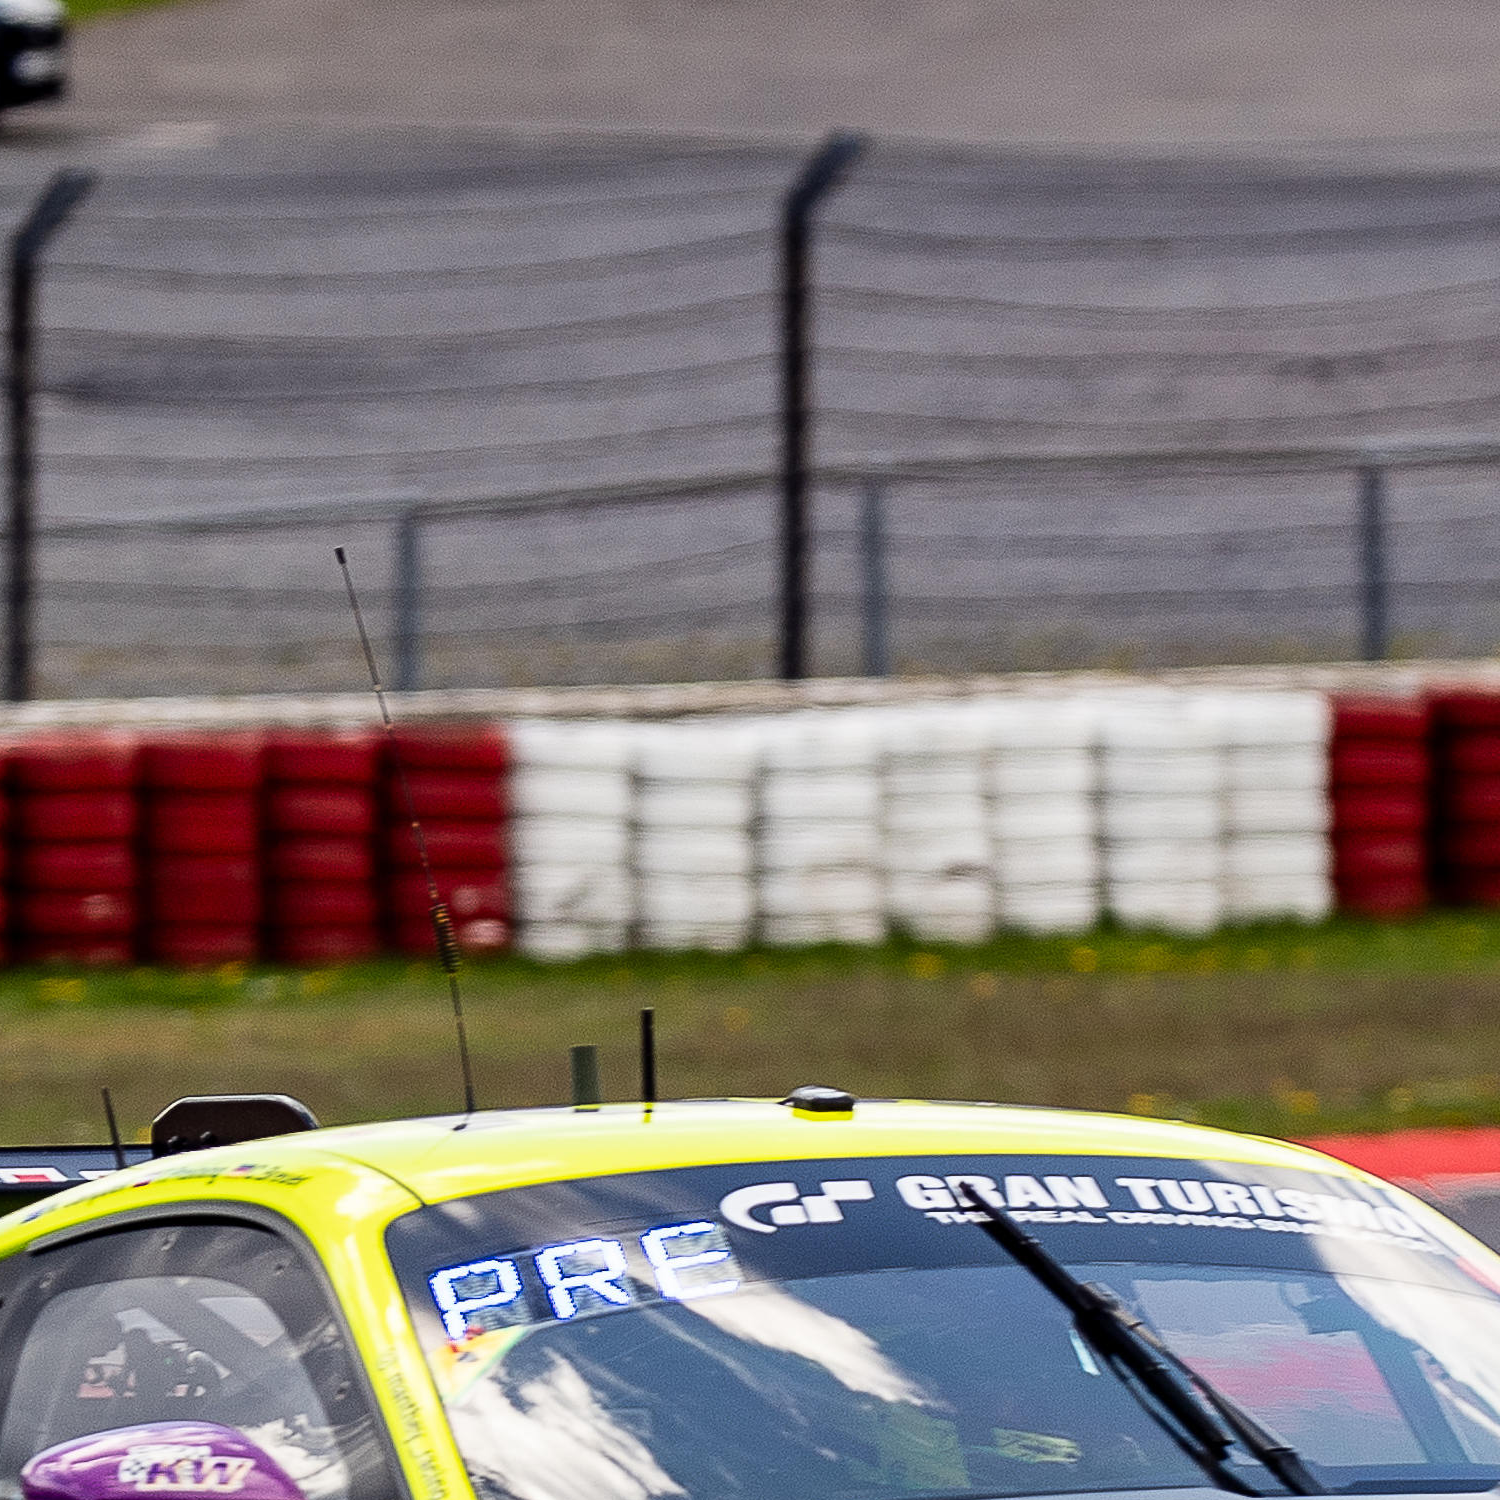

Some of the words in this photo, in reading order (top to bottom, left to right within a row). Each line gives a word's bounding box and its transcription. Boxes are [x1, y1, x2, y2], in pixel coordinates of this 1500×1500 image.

[896, 1175, 1110, 1210] GRAN
[1114, 1176, 1428, 1239] TURISMO
[430, 1219, 742, 1341] PRE
